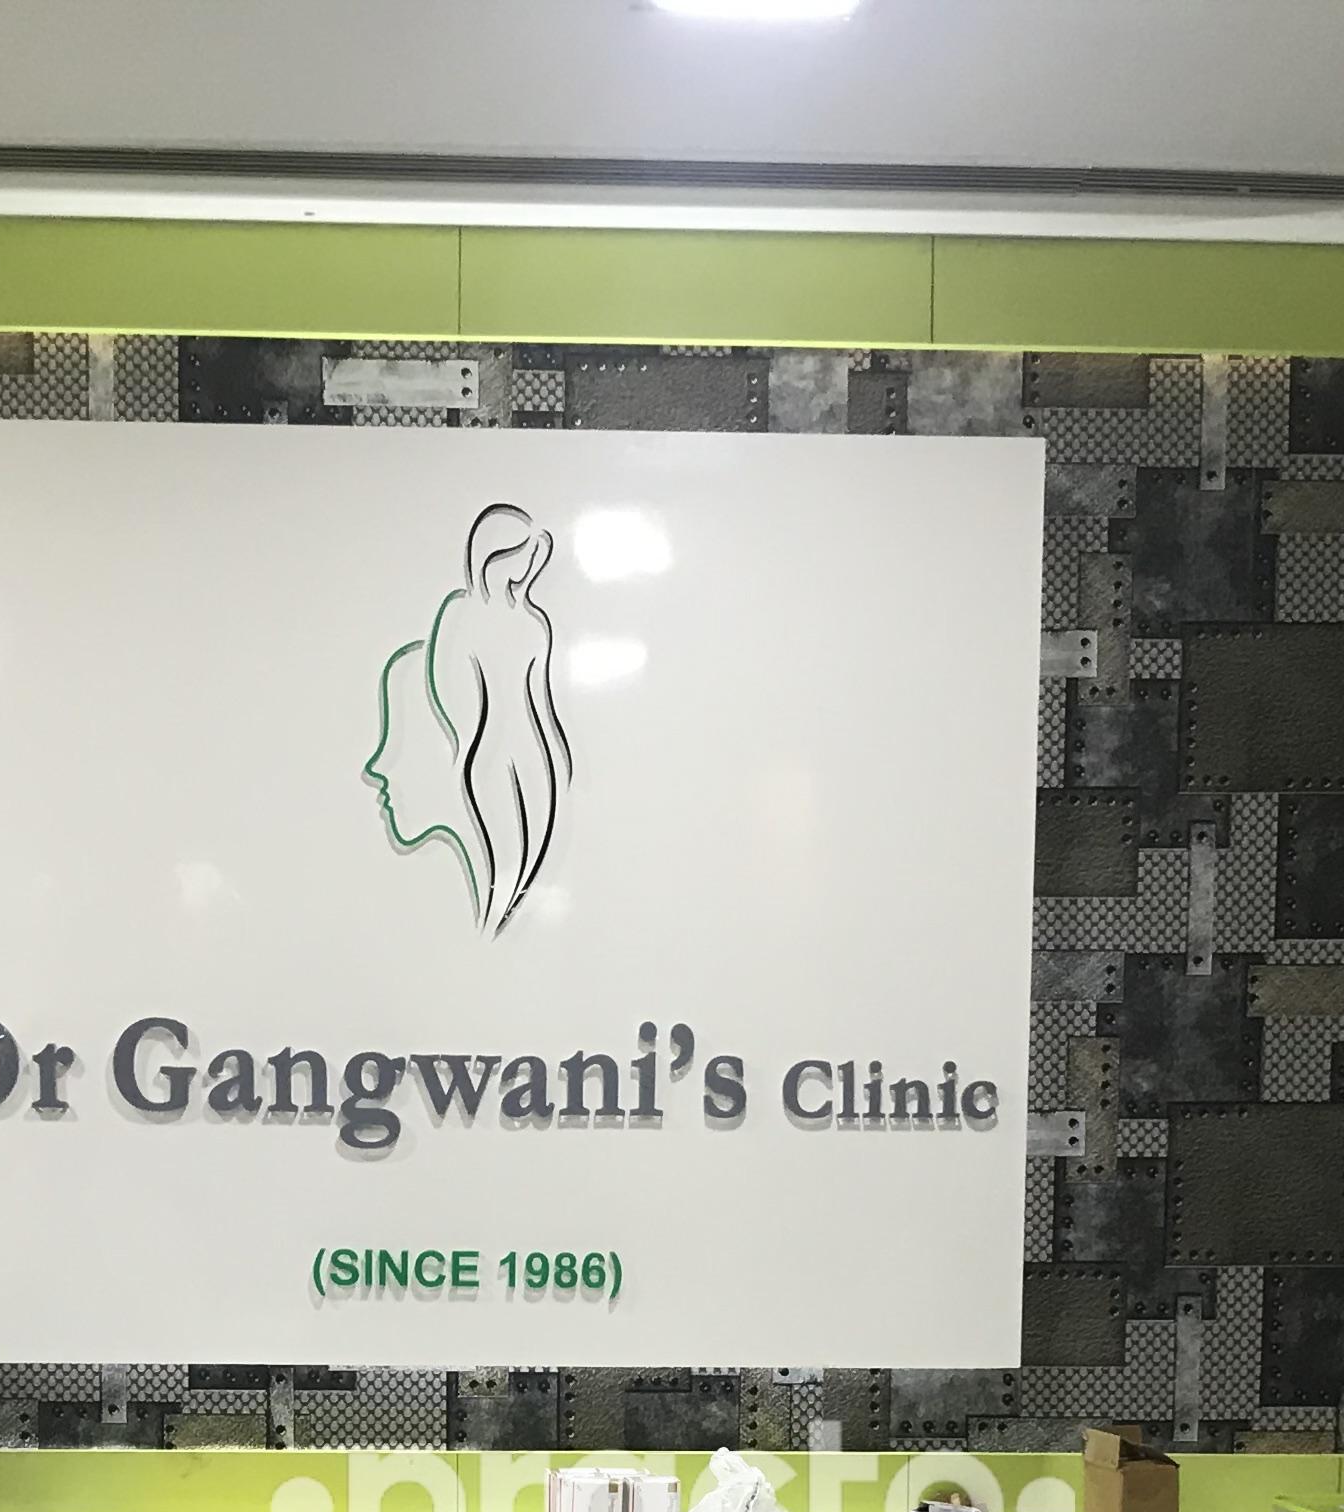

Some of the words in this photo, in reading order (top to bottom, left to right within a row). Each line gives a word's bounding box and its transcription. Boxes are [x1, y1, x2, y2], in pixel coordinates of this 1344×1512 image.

[112, 1017, 747, 1149] Gangwani's
[782, 1060, 998, 1119] Clinic
[313, 1248, 480, 1297] (SINCE
[499, 1251, 623, 1300] 1986)
